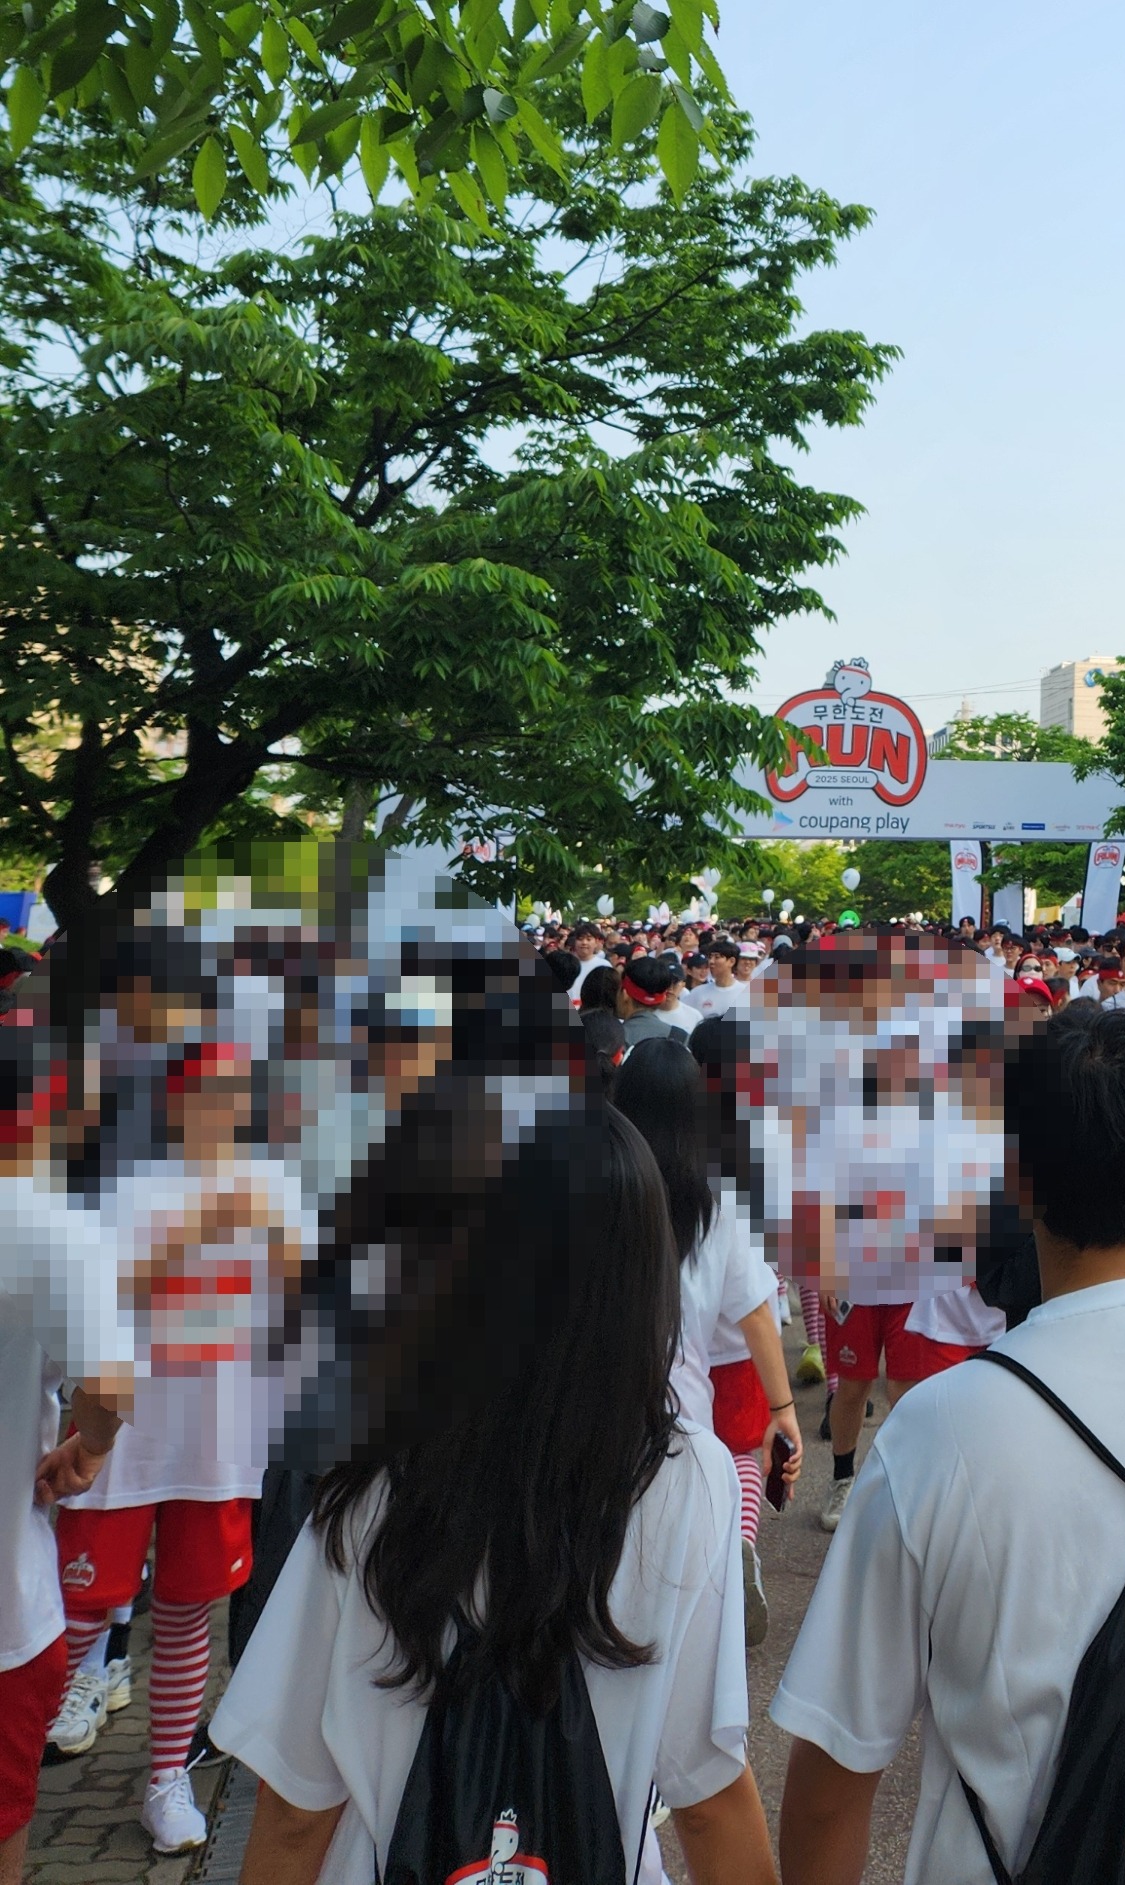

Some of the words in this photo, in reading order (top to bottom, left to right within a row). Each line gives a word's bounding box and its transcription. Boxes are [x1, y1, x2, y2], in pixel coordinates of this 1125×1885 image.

[813, 704, 884, 723] 무한도전
[815, 775, 838, 784] 2025
[840, 775, 870, 784] SEOUL
[829, 795, 853, 806] with
[799, 815, 871, 833] coupang
[876, 812, 910, 833] play
